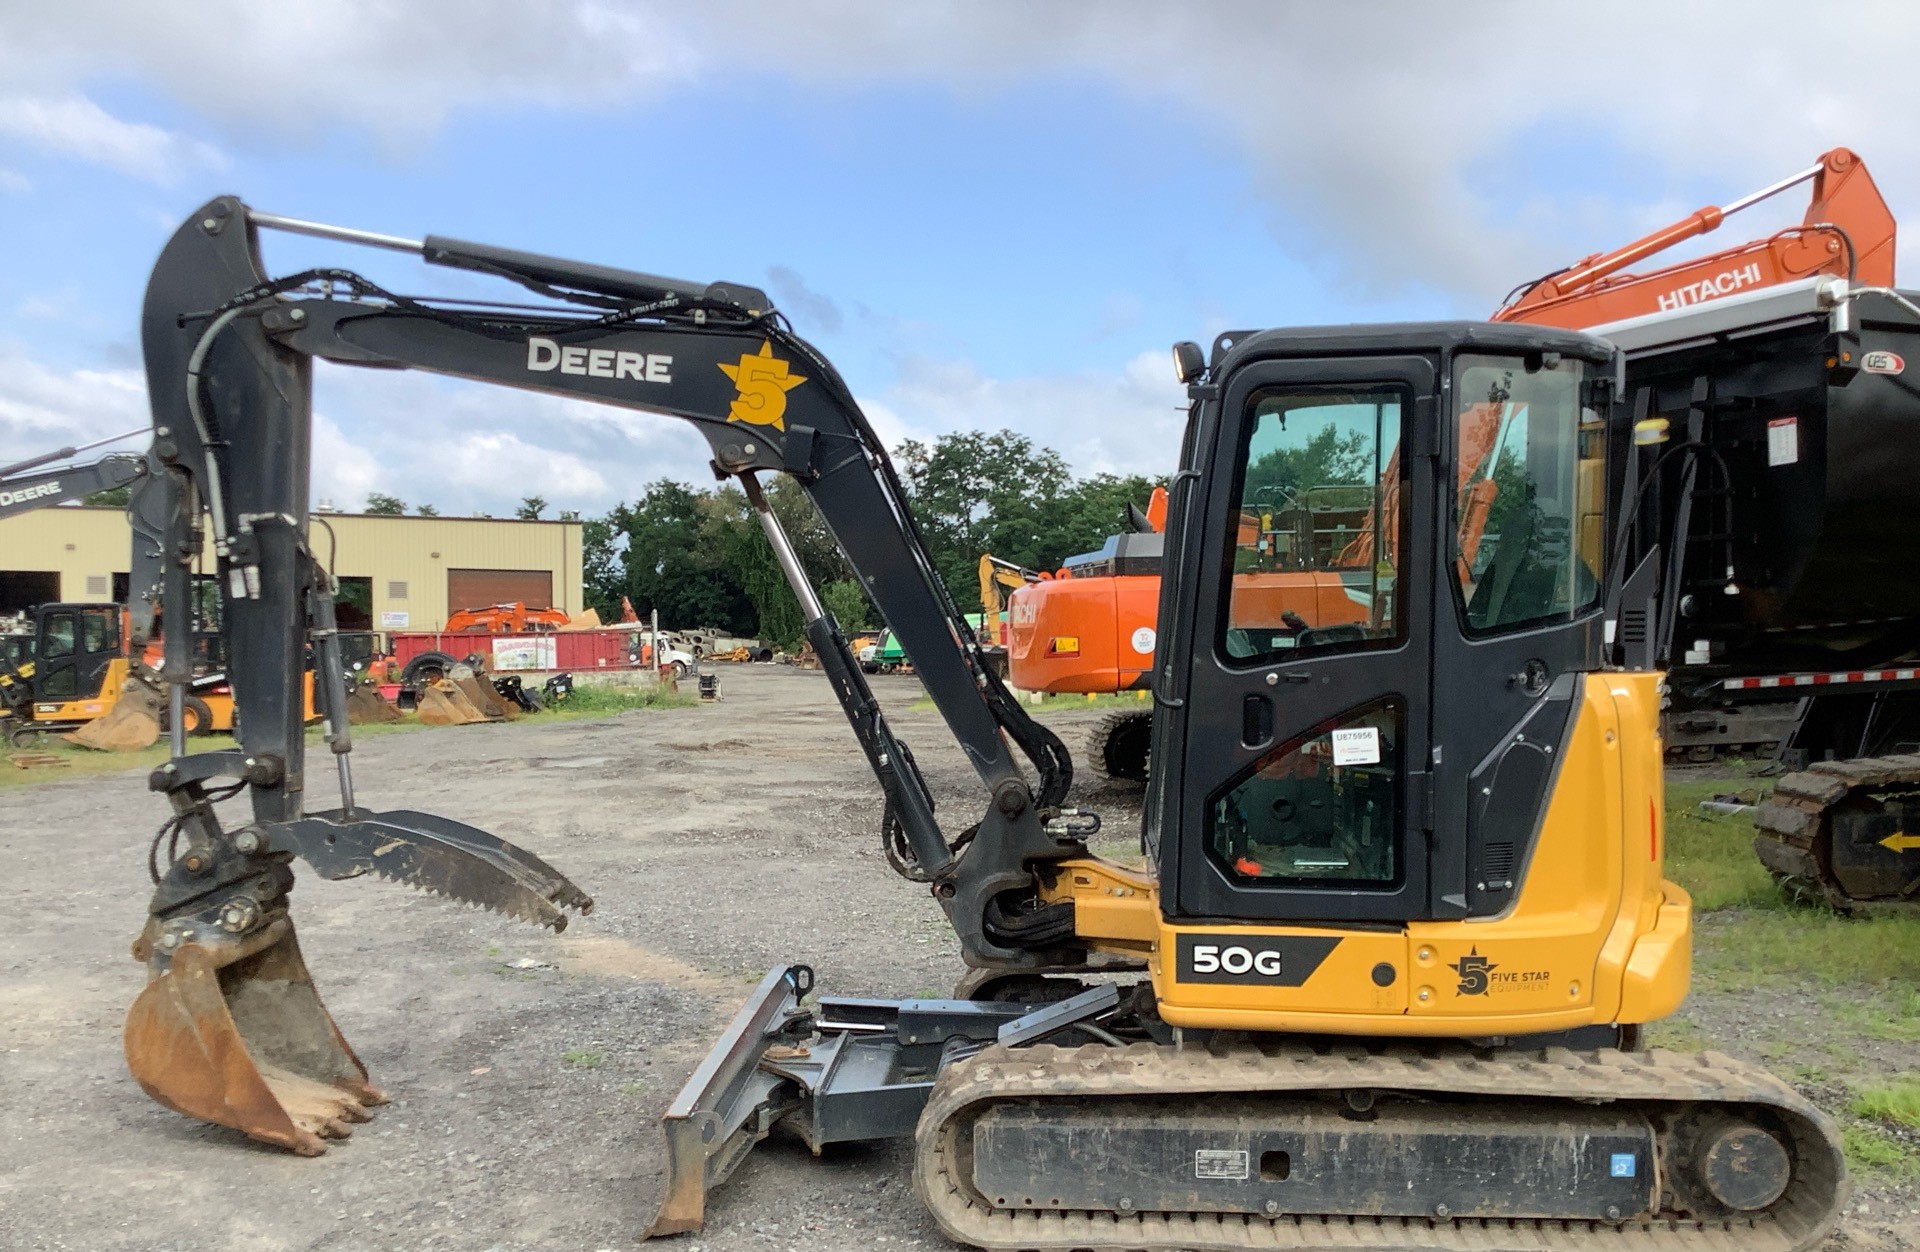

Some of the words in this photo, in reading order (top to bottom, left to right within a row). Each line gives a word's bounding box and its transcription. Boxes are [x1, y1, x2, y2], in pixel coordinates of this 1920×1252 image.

[1657, 262, 1762, 312] HITACHI
[527, 337, 674, 384] DEERE
[731, 353, 790, 426] 5
[0, 480, 63, 507] DEERE
[1336, 731, 1373, 741] U875956
[1193, 945, 1281, 976] 50G
[1456, 956, 1489, 996] 5
[1490, 982, 1550, 994] EQUIPMENT
[1491, 973, 1519, 983] FIVE
[1522, 971, 1550, 982] STAR
